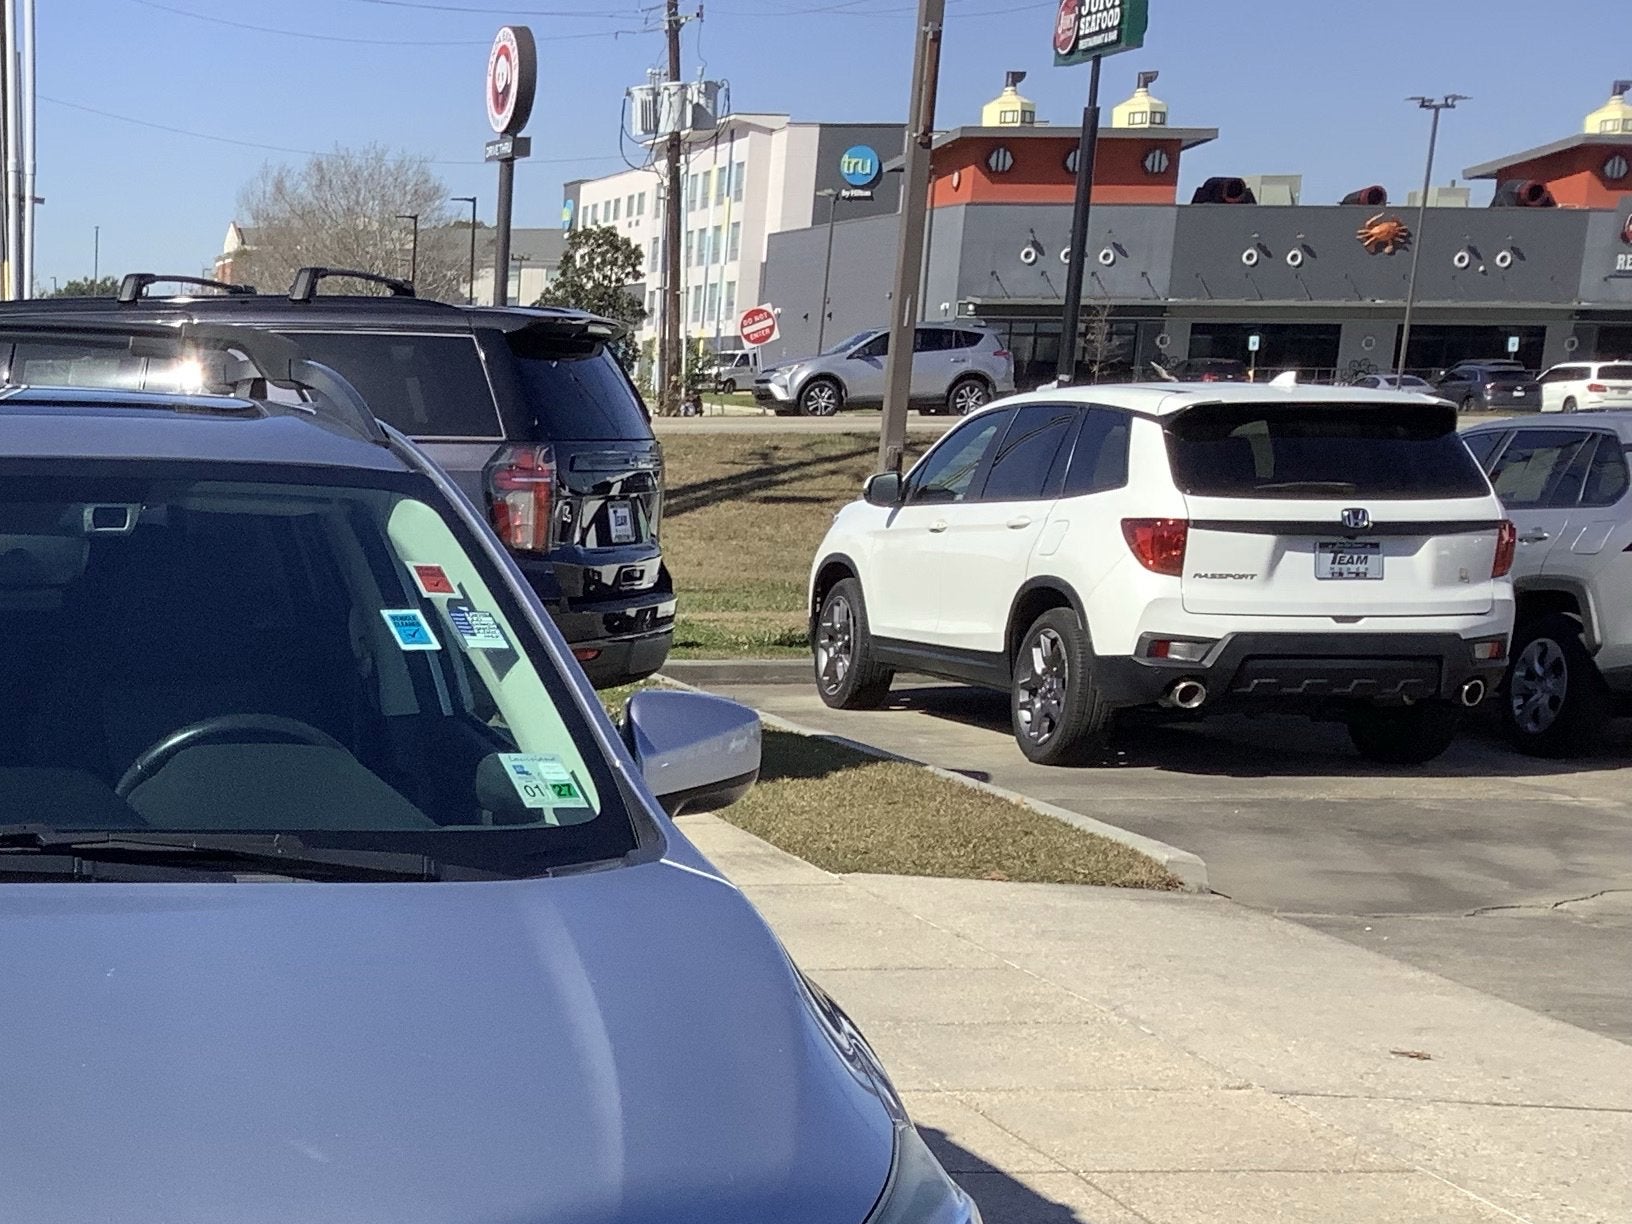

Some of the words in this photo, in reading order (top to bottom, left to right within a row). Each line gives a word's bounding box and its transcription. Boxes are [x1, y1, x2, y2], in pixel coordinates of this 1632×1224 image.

[1079, 7, 1120, 36] SEAFOOD
[841, 154, 871, 175] tru
[743, 317, 753, 326] DO
[754, 311, 768, 322] NOT
[749, 328, 771, 340] ENTER
[1329, 550, 1368, 566] TEAM
[524, 784, 545, 797] 01
[551, 783, 574, 797] 27
